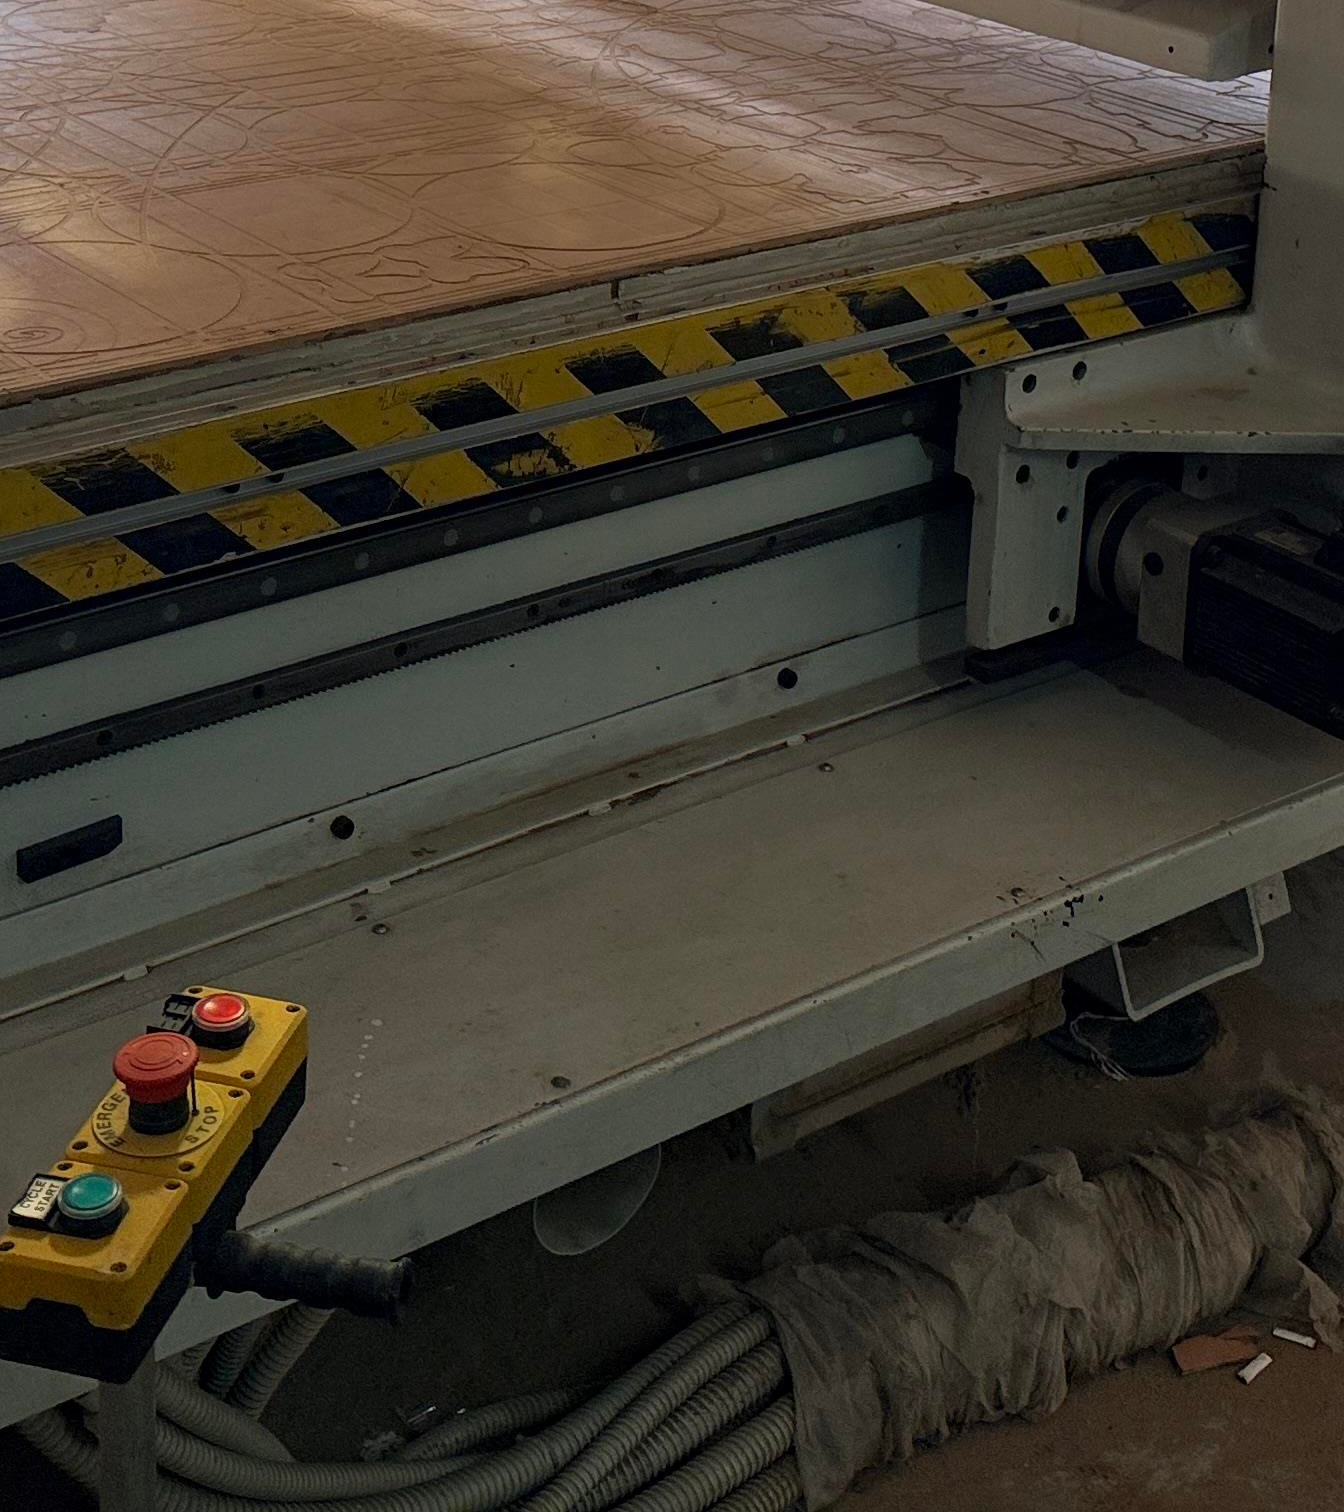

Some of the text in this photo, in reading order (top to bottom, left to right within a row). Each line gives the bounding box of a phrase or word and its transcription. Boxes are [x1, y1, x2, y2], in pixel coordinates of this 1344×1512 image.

[185, 1105, 219, 1144] STOP
[20, 1180, 47, 1209] CYCLE
[34, 1183, 60, 1213] START
